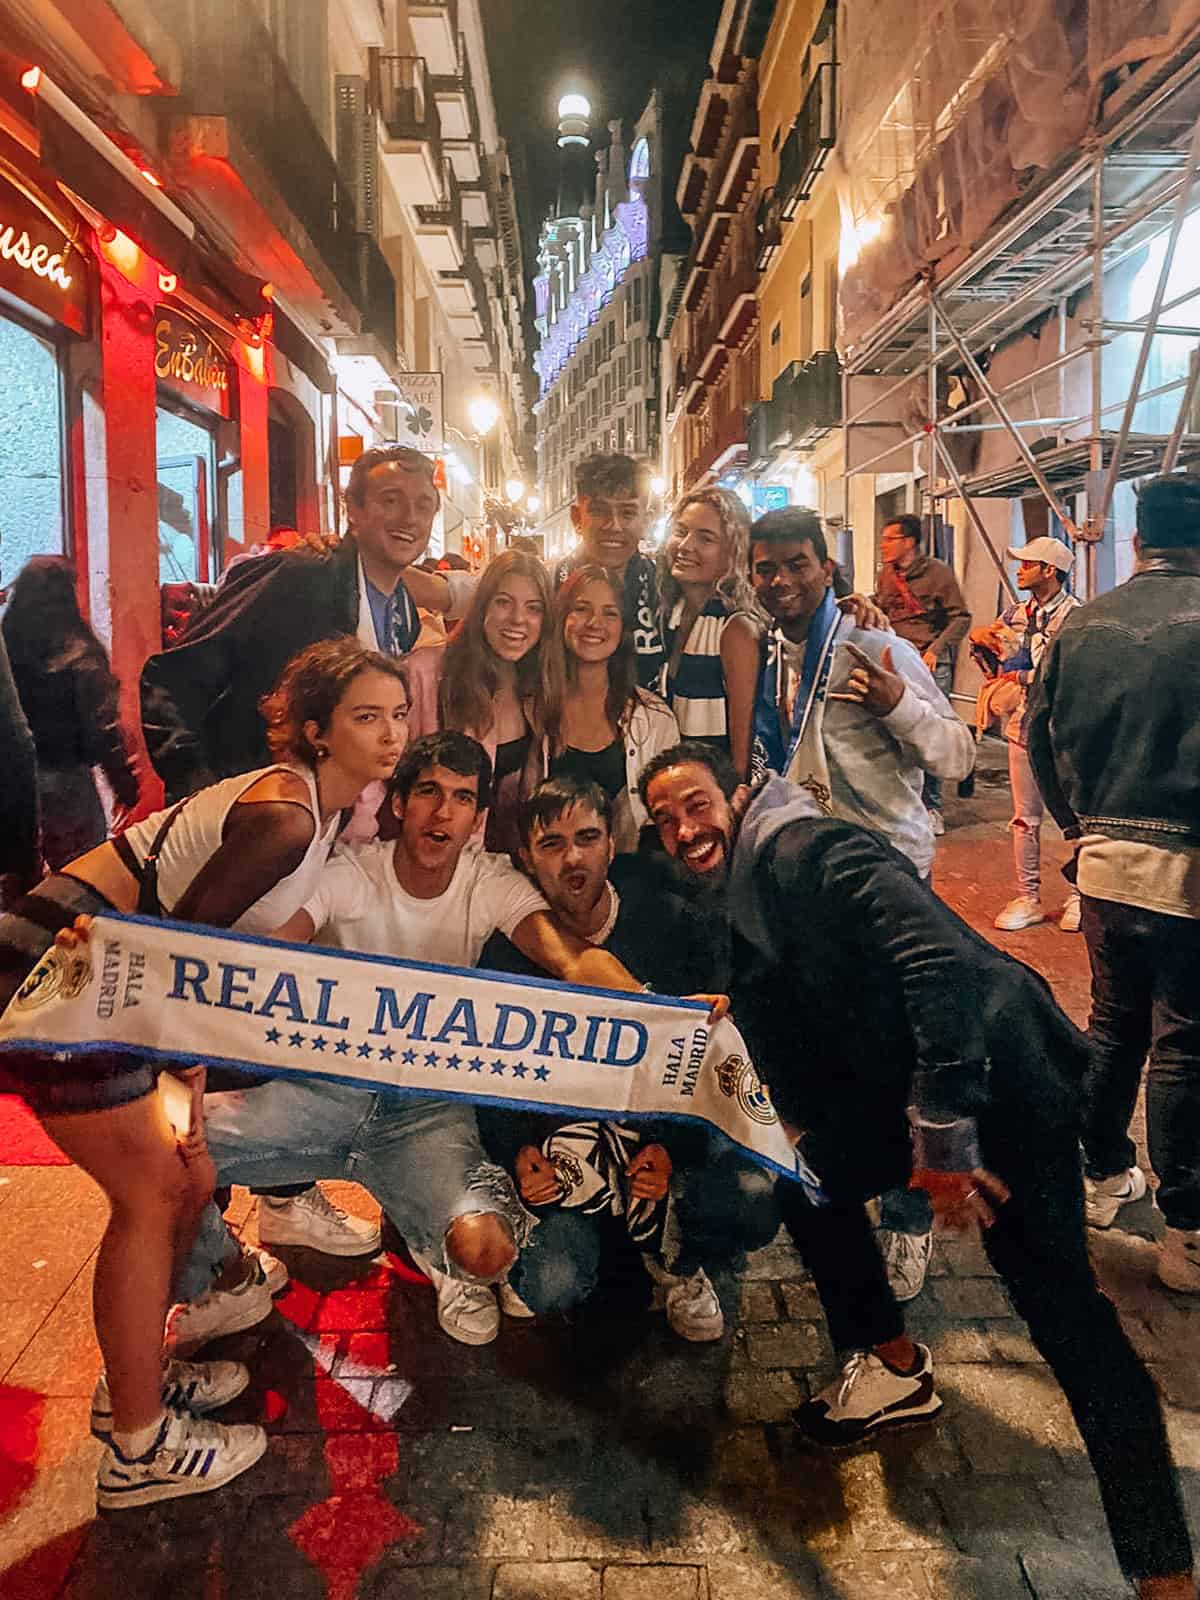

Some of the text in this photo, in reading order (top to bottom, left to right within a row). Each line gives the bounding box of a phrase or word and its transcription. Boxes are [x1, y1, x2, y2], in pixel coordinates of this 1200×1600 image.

[400, 375, 438, 386] PIZZA
[97, 941, 120, 1019] MADRID
[122, 951, 145, 1008] HALA
[166, 954, 649, 1068] REAL MADRID
[662, 1037, 685, 1086] HALA
[680, 1027, 709, 1097] MADRID
